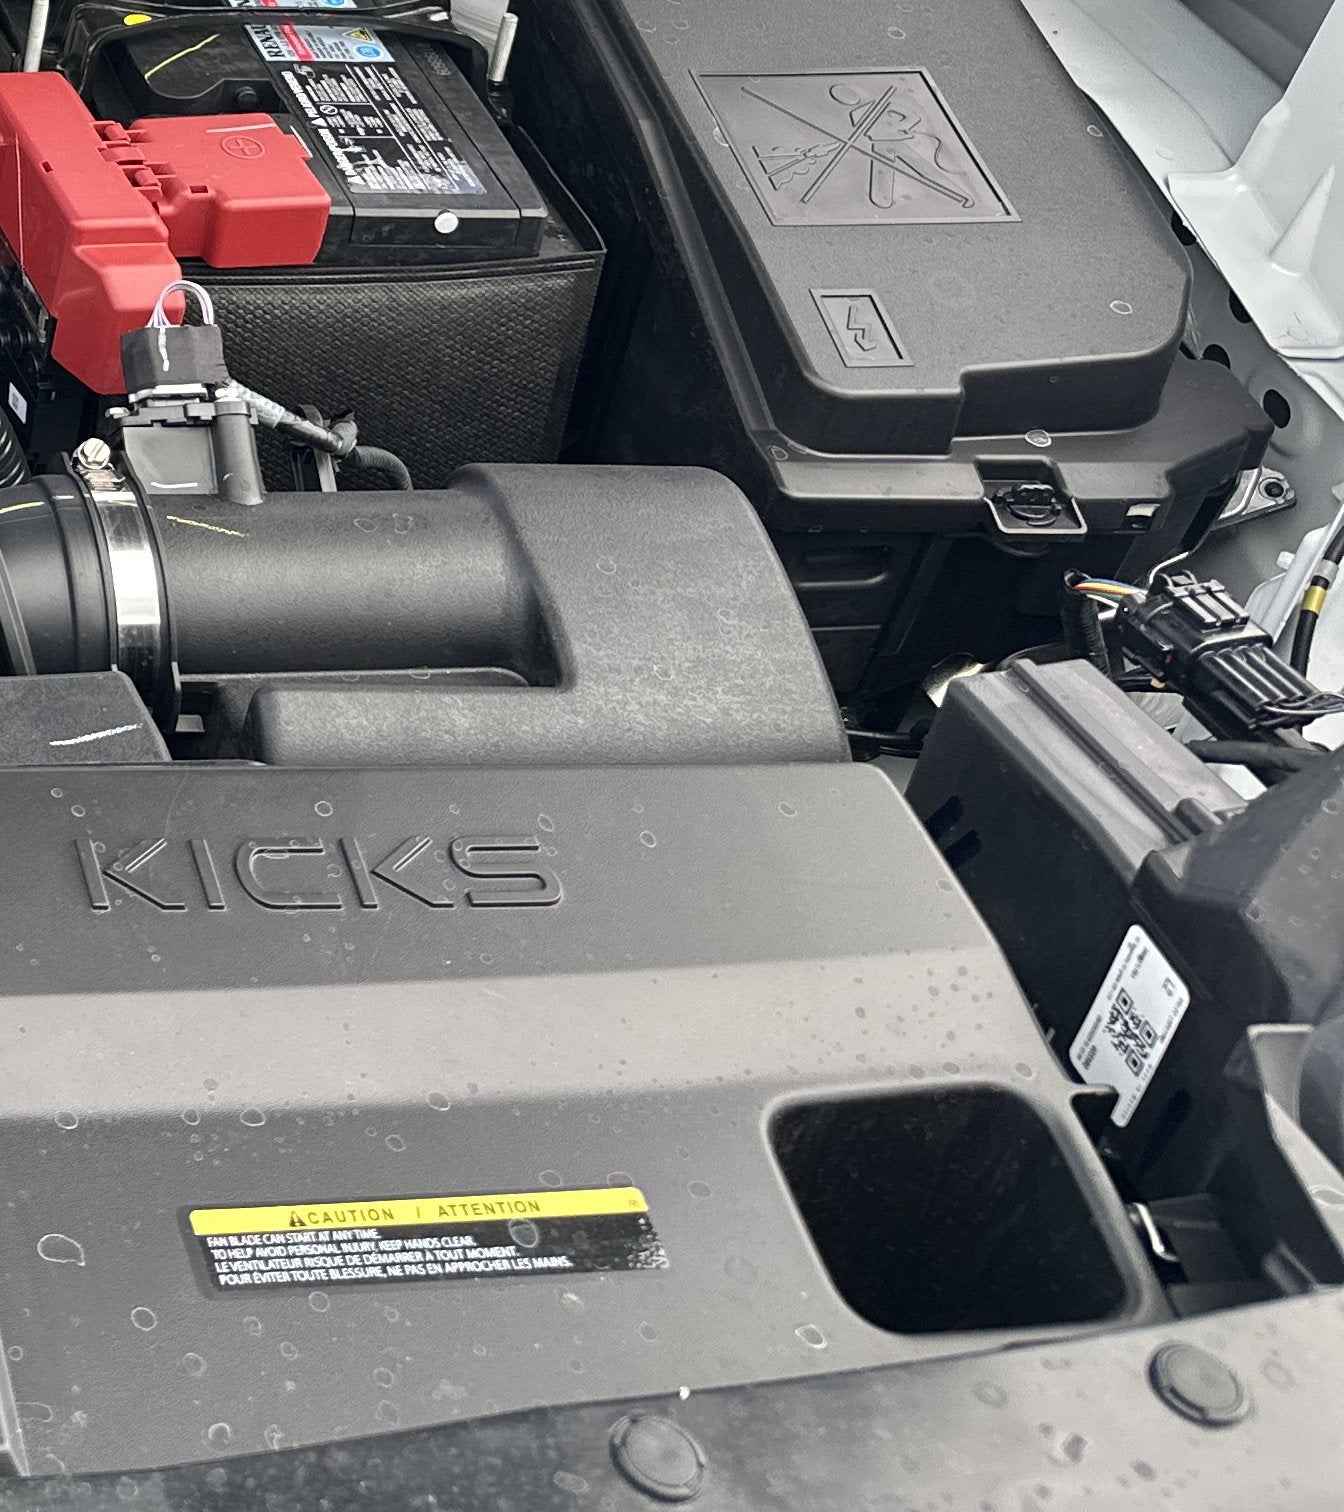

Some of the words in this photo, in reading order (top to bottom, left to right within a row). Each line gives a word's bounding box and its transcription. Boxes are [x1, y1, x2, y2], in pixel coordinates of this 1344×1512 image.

[73, 836, 564, 913] KICKS
[307, 1208, 395, 1225] CAUTION
[437, 1200, 541, 1218] ATTENTION
[207, 1235, 228, 1248] FAN
[229, 1234, 261, 1246] BLADE
[262, 1233, 284, 1245] CAN
[285, 1231, 318, 1244] START
[319, 1231, 332, 1242] AT
[332, 1230, 352, 1241] ANY
[350, 1228, 380, 1240] TIME.
[228, 1248, 253, 1259] HELP
[256, 1246, 286, 1258] AVOID
[288, 1243, 340, 1256] PERSONAL
[341, 1241, 377, 1254] INJURY,
[378, 1240, 403, 1251] KEEP
[405, 1237, 440, 1249] HANDS
[441, 1236, 476, 1247] CLEAR.
[219, 1274, 252, 1286] POUR
[254, 1270, 291, 1284] ÉVITER
[291, 1269, 328, 1283] TOUTE
[329, 1266, 387, 1281] BLESSURE,
[404, 1264, 425, 1276] PAS
[445, 1258, 512, 1273] APPROCHER
[513, 1257, 531, 1269] LES
[532, 1255, 574, 1268] MAINS.
[229, 1259, 302, 1273] VENTILATEUR
[304, 1257, 344, 1269] RISQUE
[364, 1251, 423, 1265] DÉMARRER
[435, 1248, 464, 1261] TOUT
[467, 1245, 519, 1258] MOMENT.
